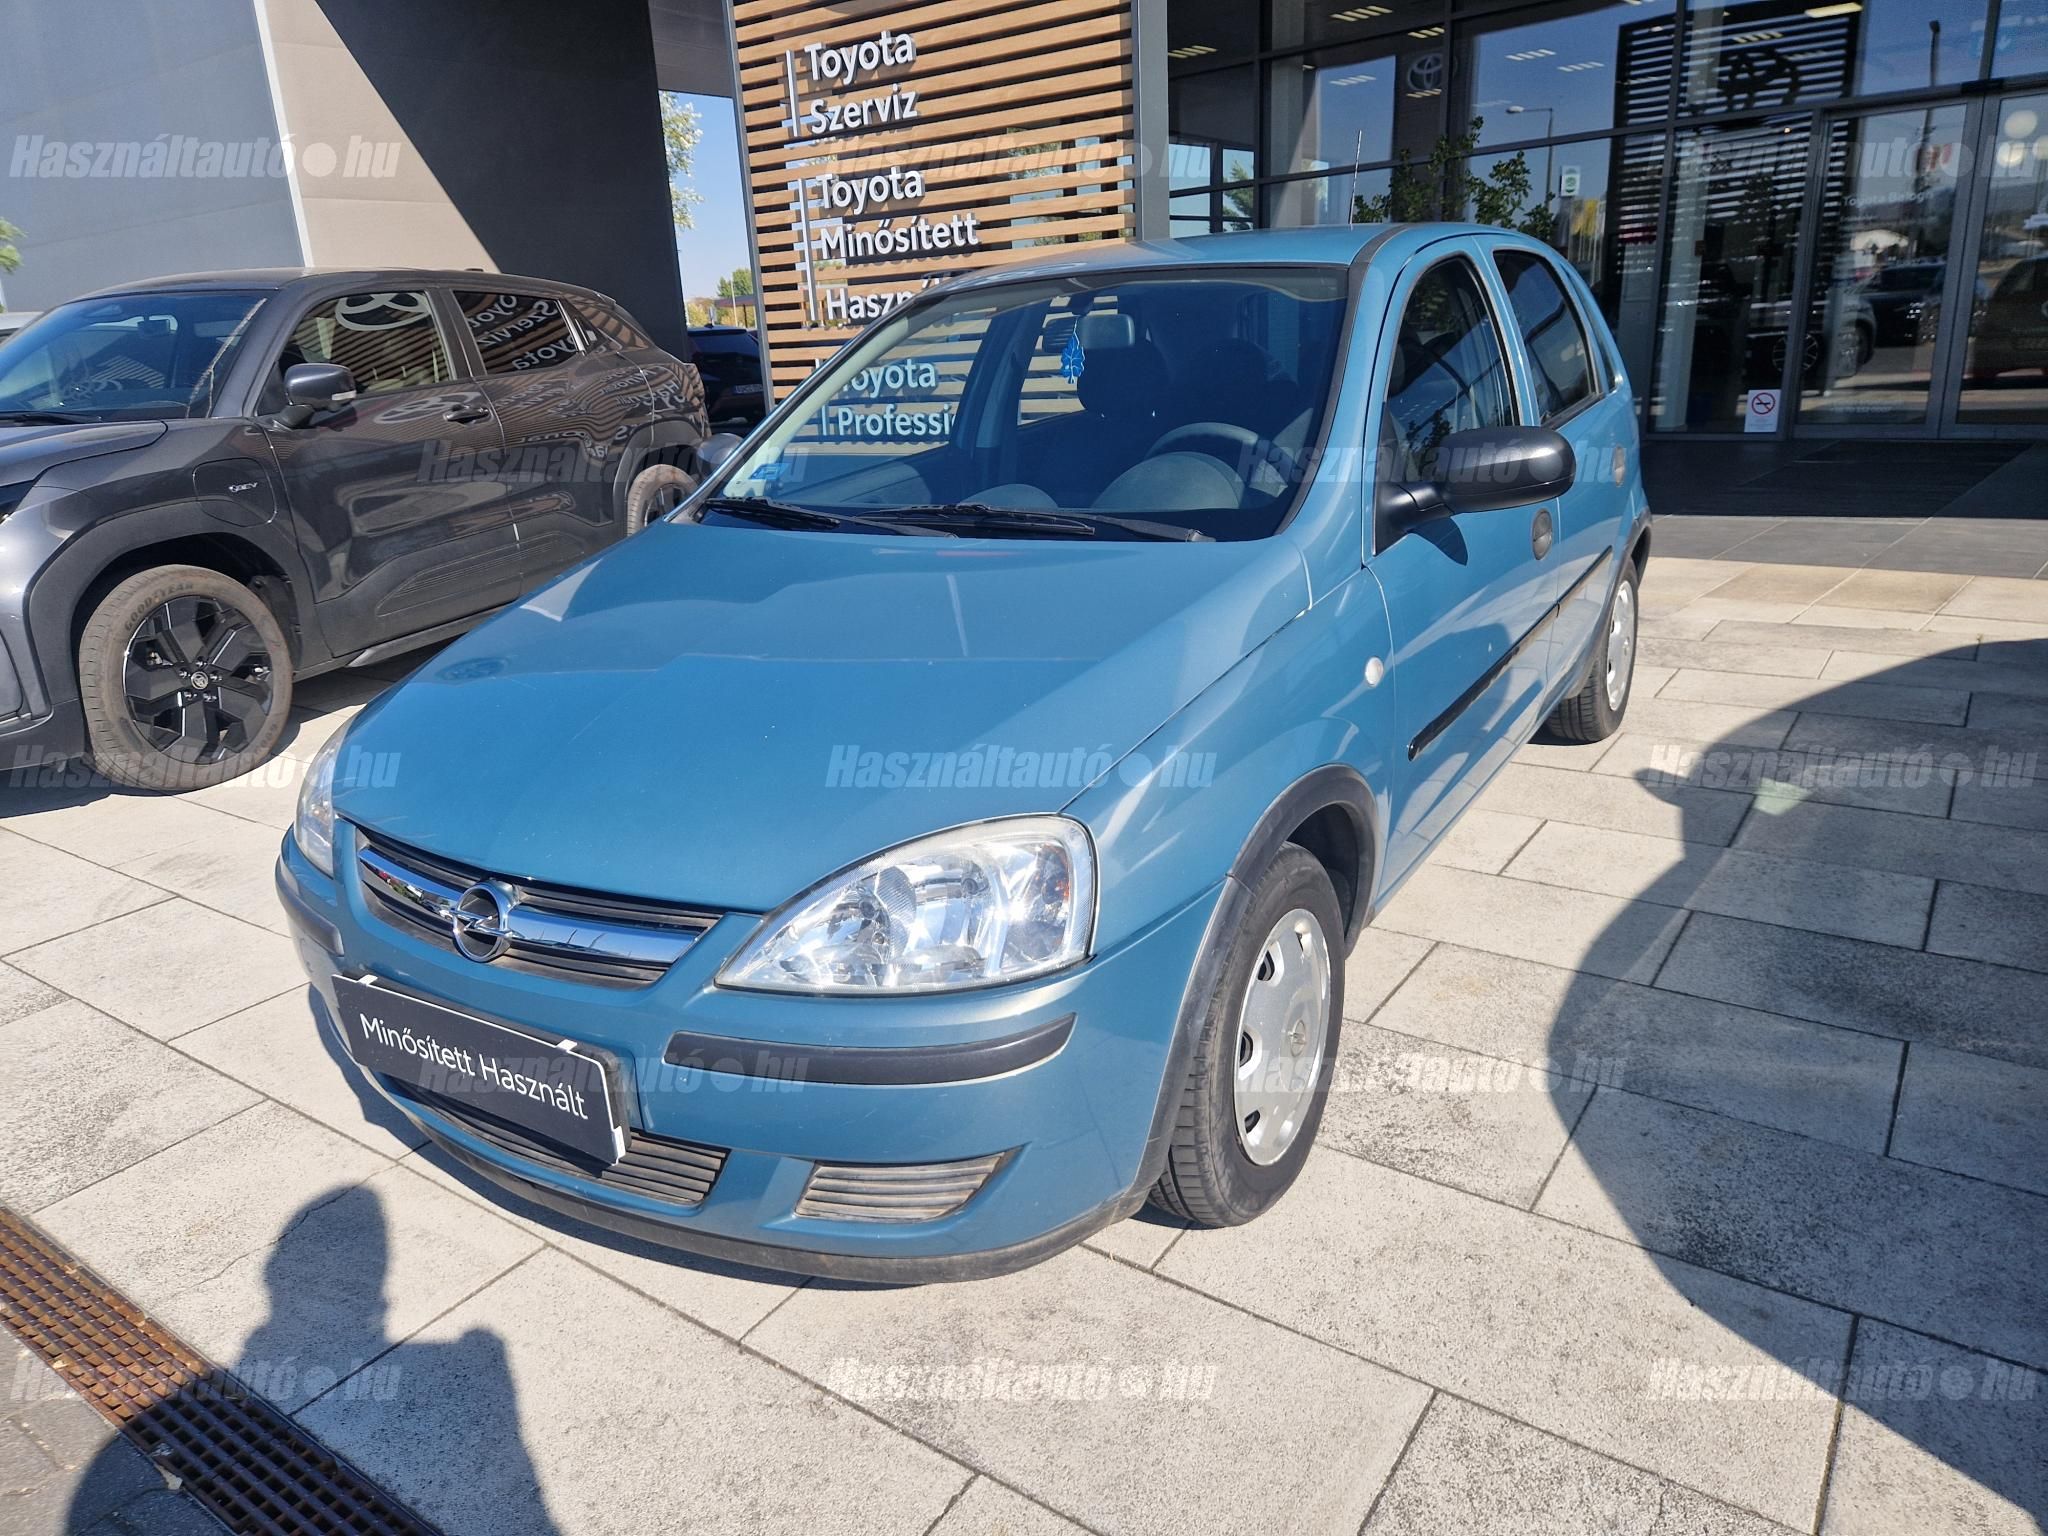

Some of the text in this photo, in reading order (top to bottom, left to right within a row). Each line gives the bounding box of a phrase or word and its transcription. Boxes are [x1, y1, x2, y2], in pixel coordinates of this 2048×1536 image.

[804, 30, 916, 85] Toyota
[810, 83, 919, 134] Szerviz
[816, 166, 925, 215] Toyota
[820, 212, 979, 260] Minősített
[842, 358, 937, 398] oyota
[838, 403, 957, 436] Professi
[359, 1012, 589, 1120] Minősített Használt
